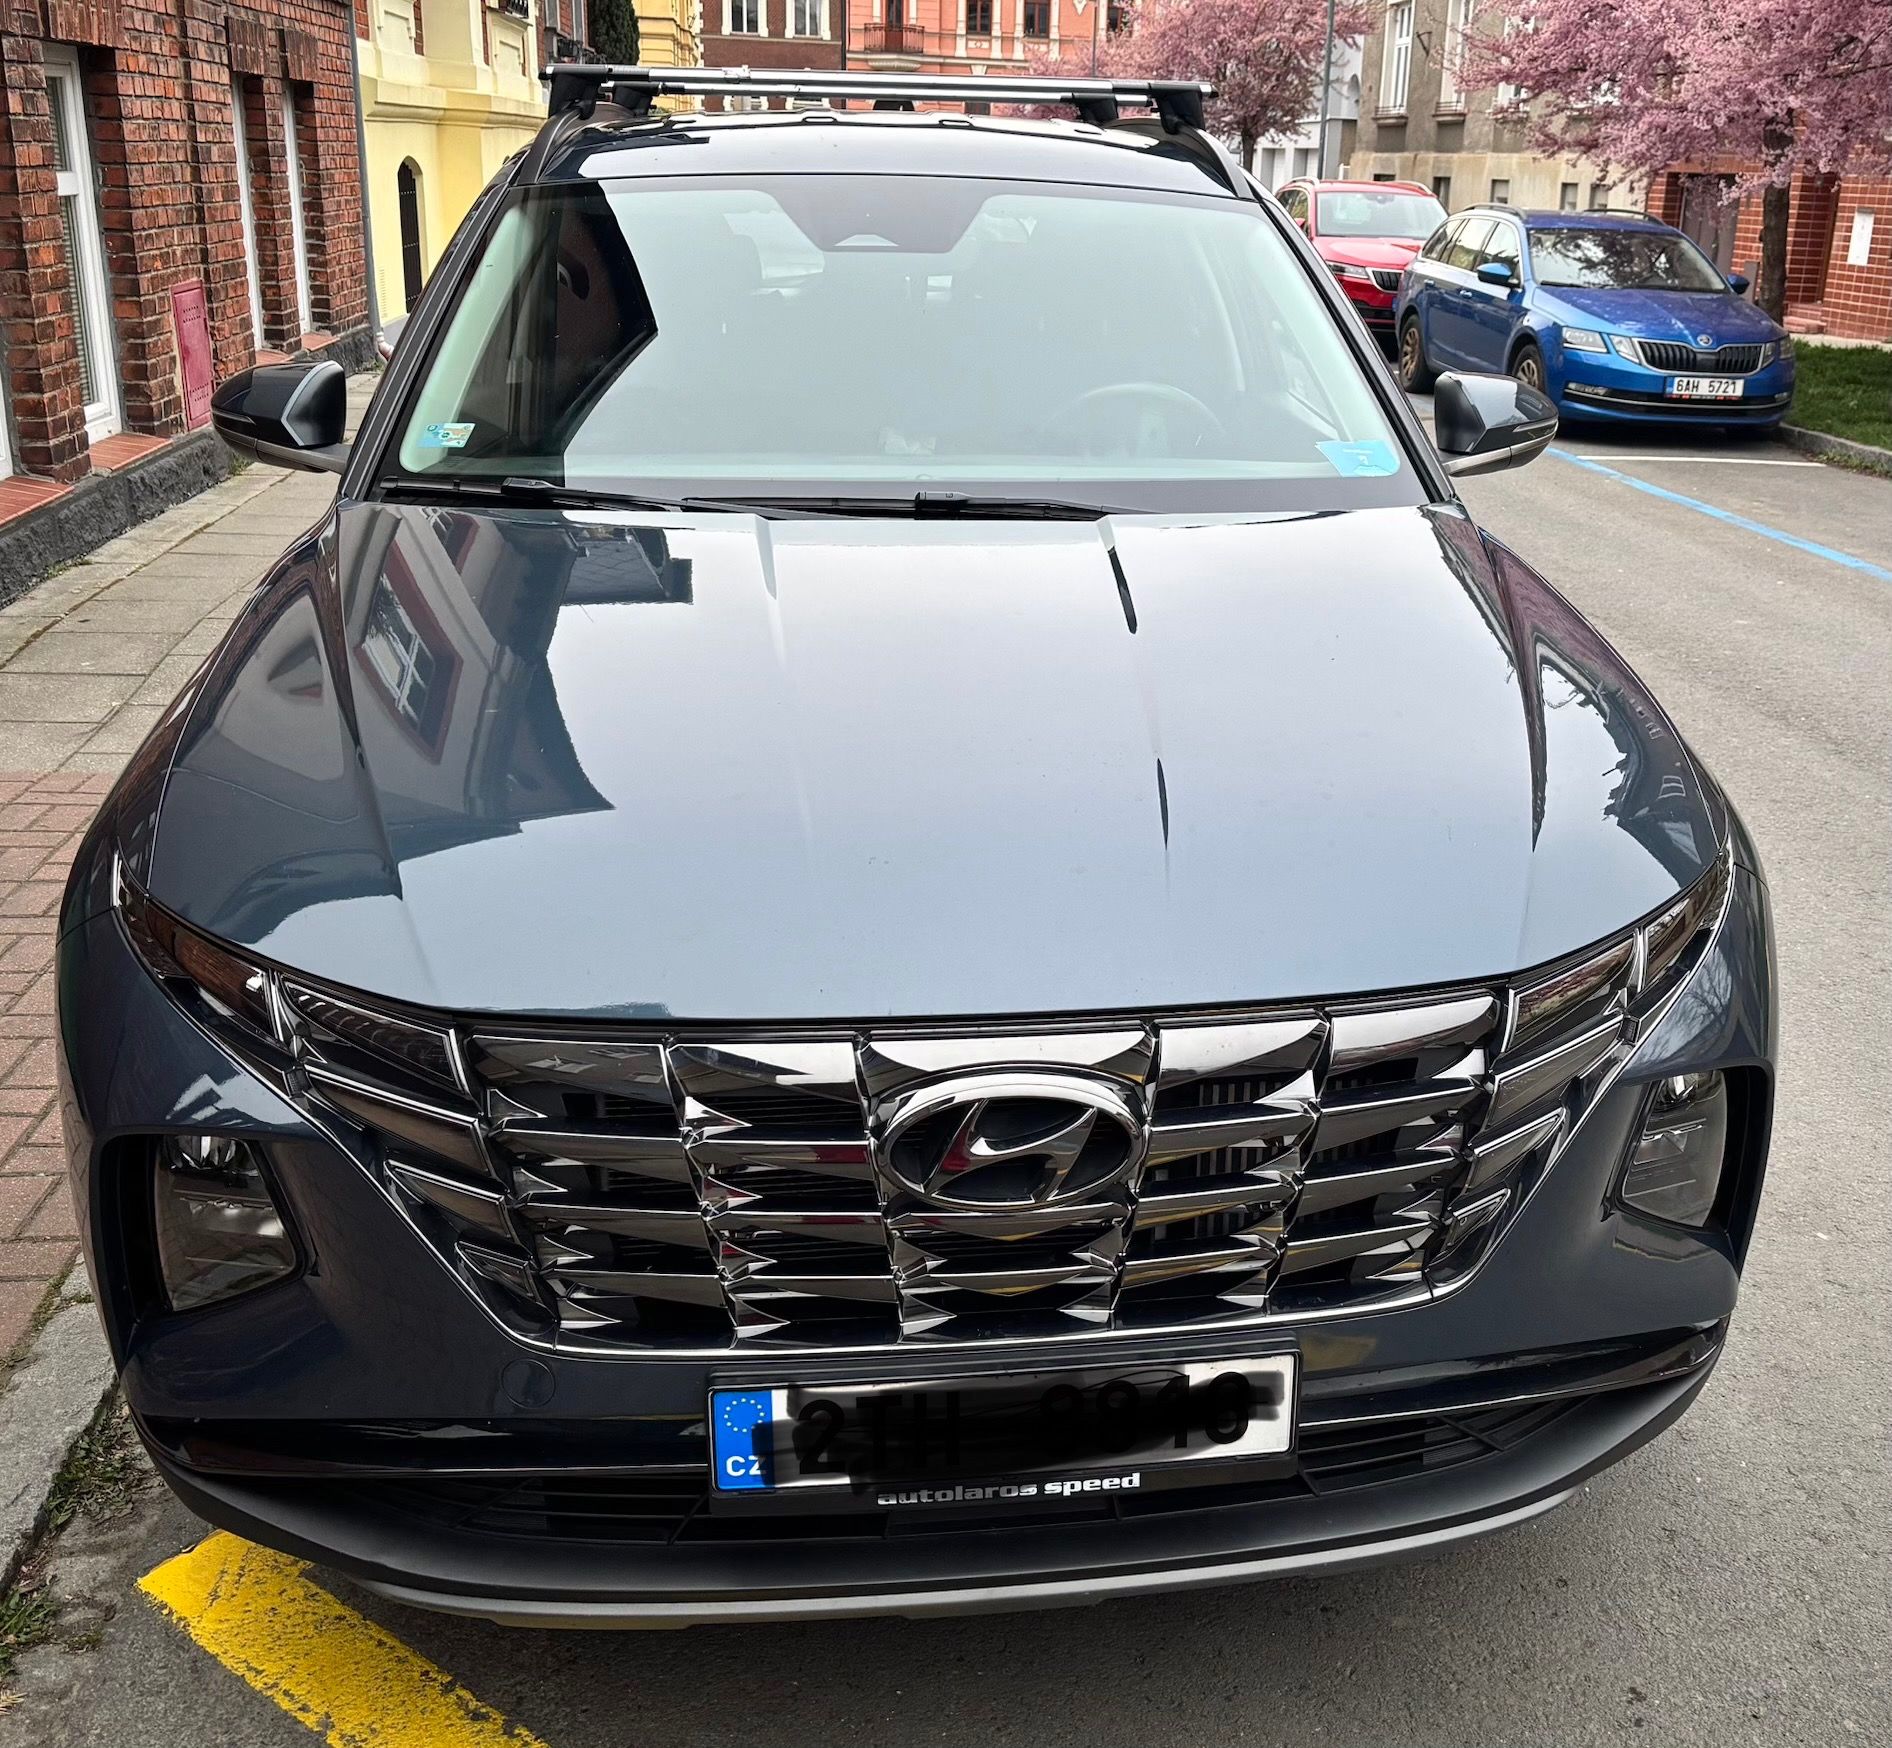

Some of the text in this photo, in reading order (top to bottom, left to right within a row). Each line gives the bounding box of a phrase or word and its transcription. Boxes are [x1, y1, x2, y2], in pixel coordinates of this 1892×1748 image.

[1676, 379, 1700, 393] 6AH
[1708, 380, 1737, 394] 5721
[725, 1455, 767, 1477] CZ
[877, 1472, 1141, 1506] autolaros speed
